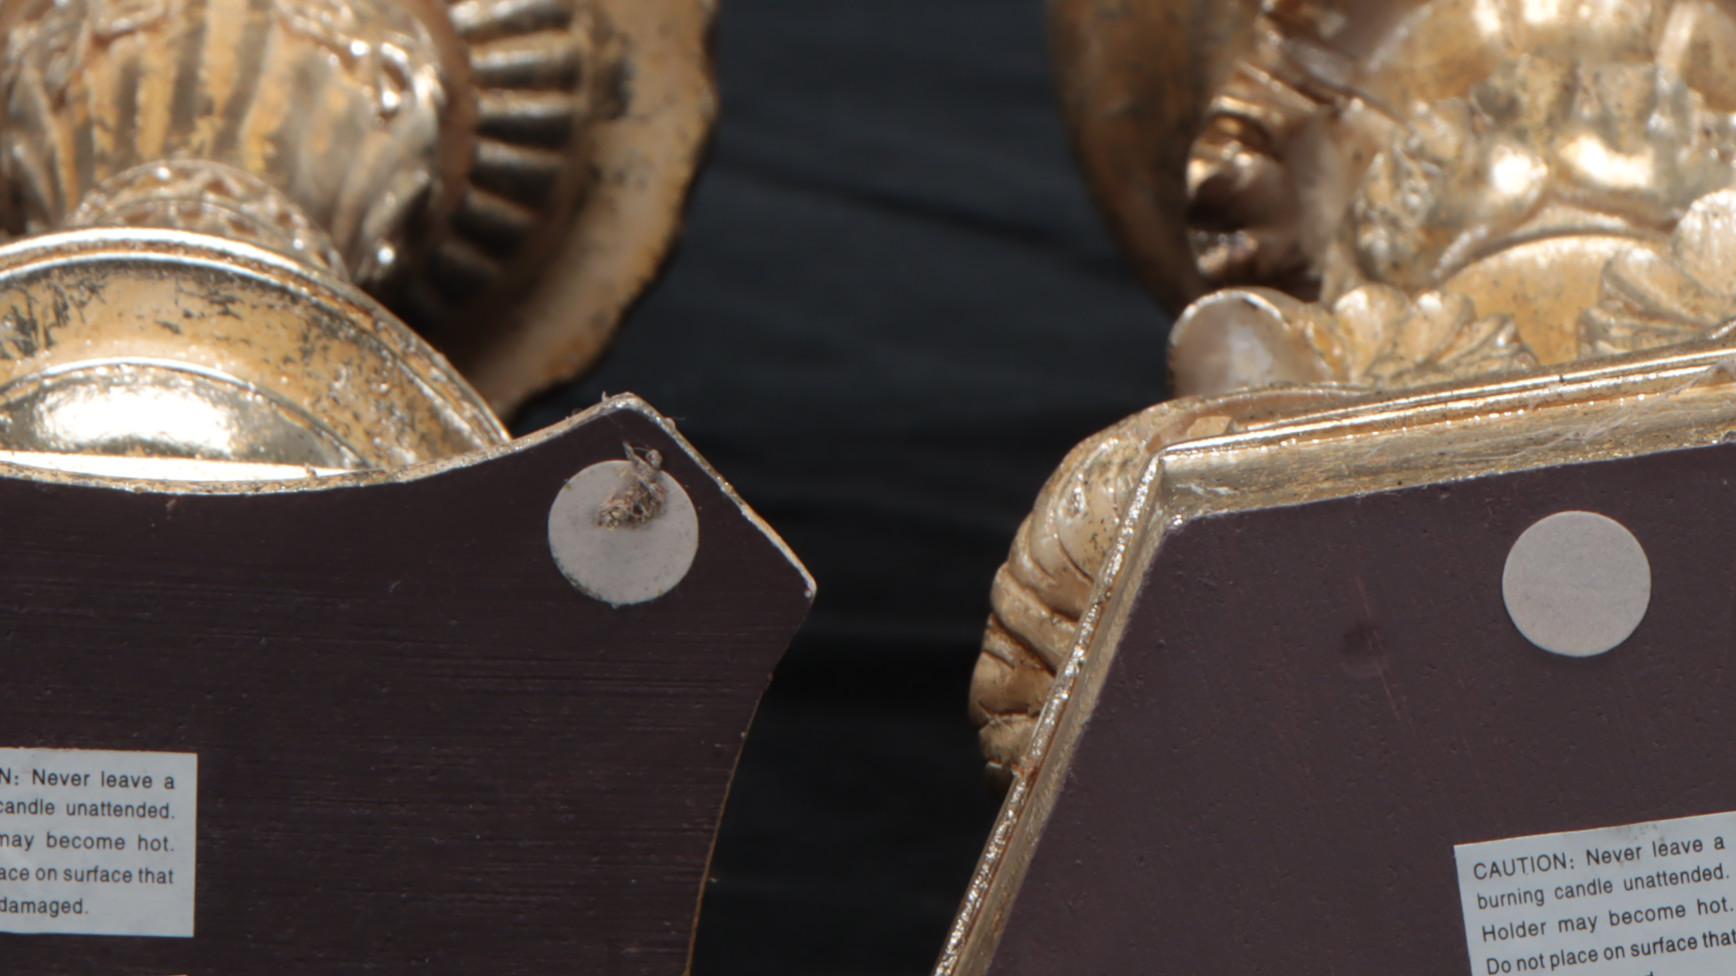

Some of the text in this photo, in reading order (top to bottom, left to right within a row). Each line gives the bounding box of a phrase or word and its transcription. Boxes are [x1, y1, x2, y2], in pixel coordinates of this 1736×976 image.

[32, 768, 91, 787] Never
[100, 770, 153, 789] leave
[163, 775, 176, 790] a
[66, 801, 175, 820] unattended.
[46, 831, 126, 850] become
[138, 834, 175, 852] hot.
[1473, 835, 1725, 881] CAUTION: Never leave a
[35, 867, 58, 881] on
[63, 865, 133, 884] surface
[138, 867, 174, 885] that
[1476, 862, 1730, 911] burning candle unattended.
[1481, 896, 1734, 943] Holder may become hot.
[1486, 957, 1512, 976] Do
[1516, 953, 1546, 972] not
[1549, 948, 1599, 972] place
[1603, 945, 1625, 962] on
[1630, 931, 1698, 957] surface
